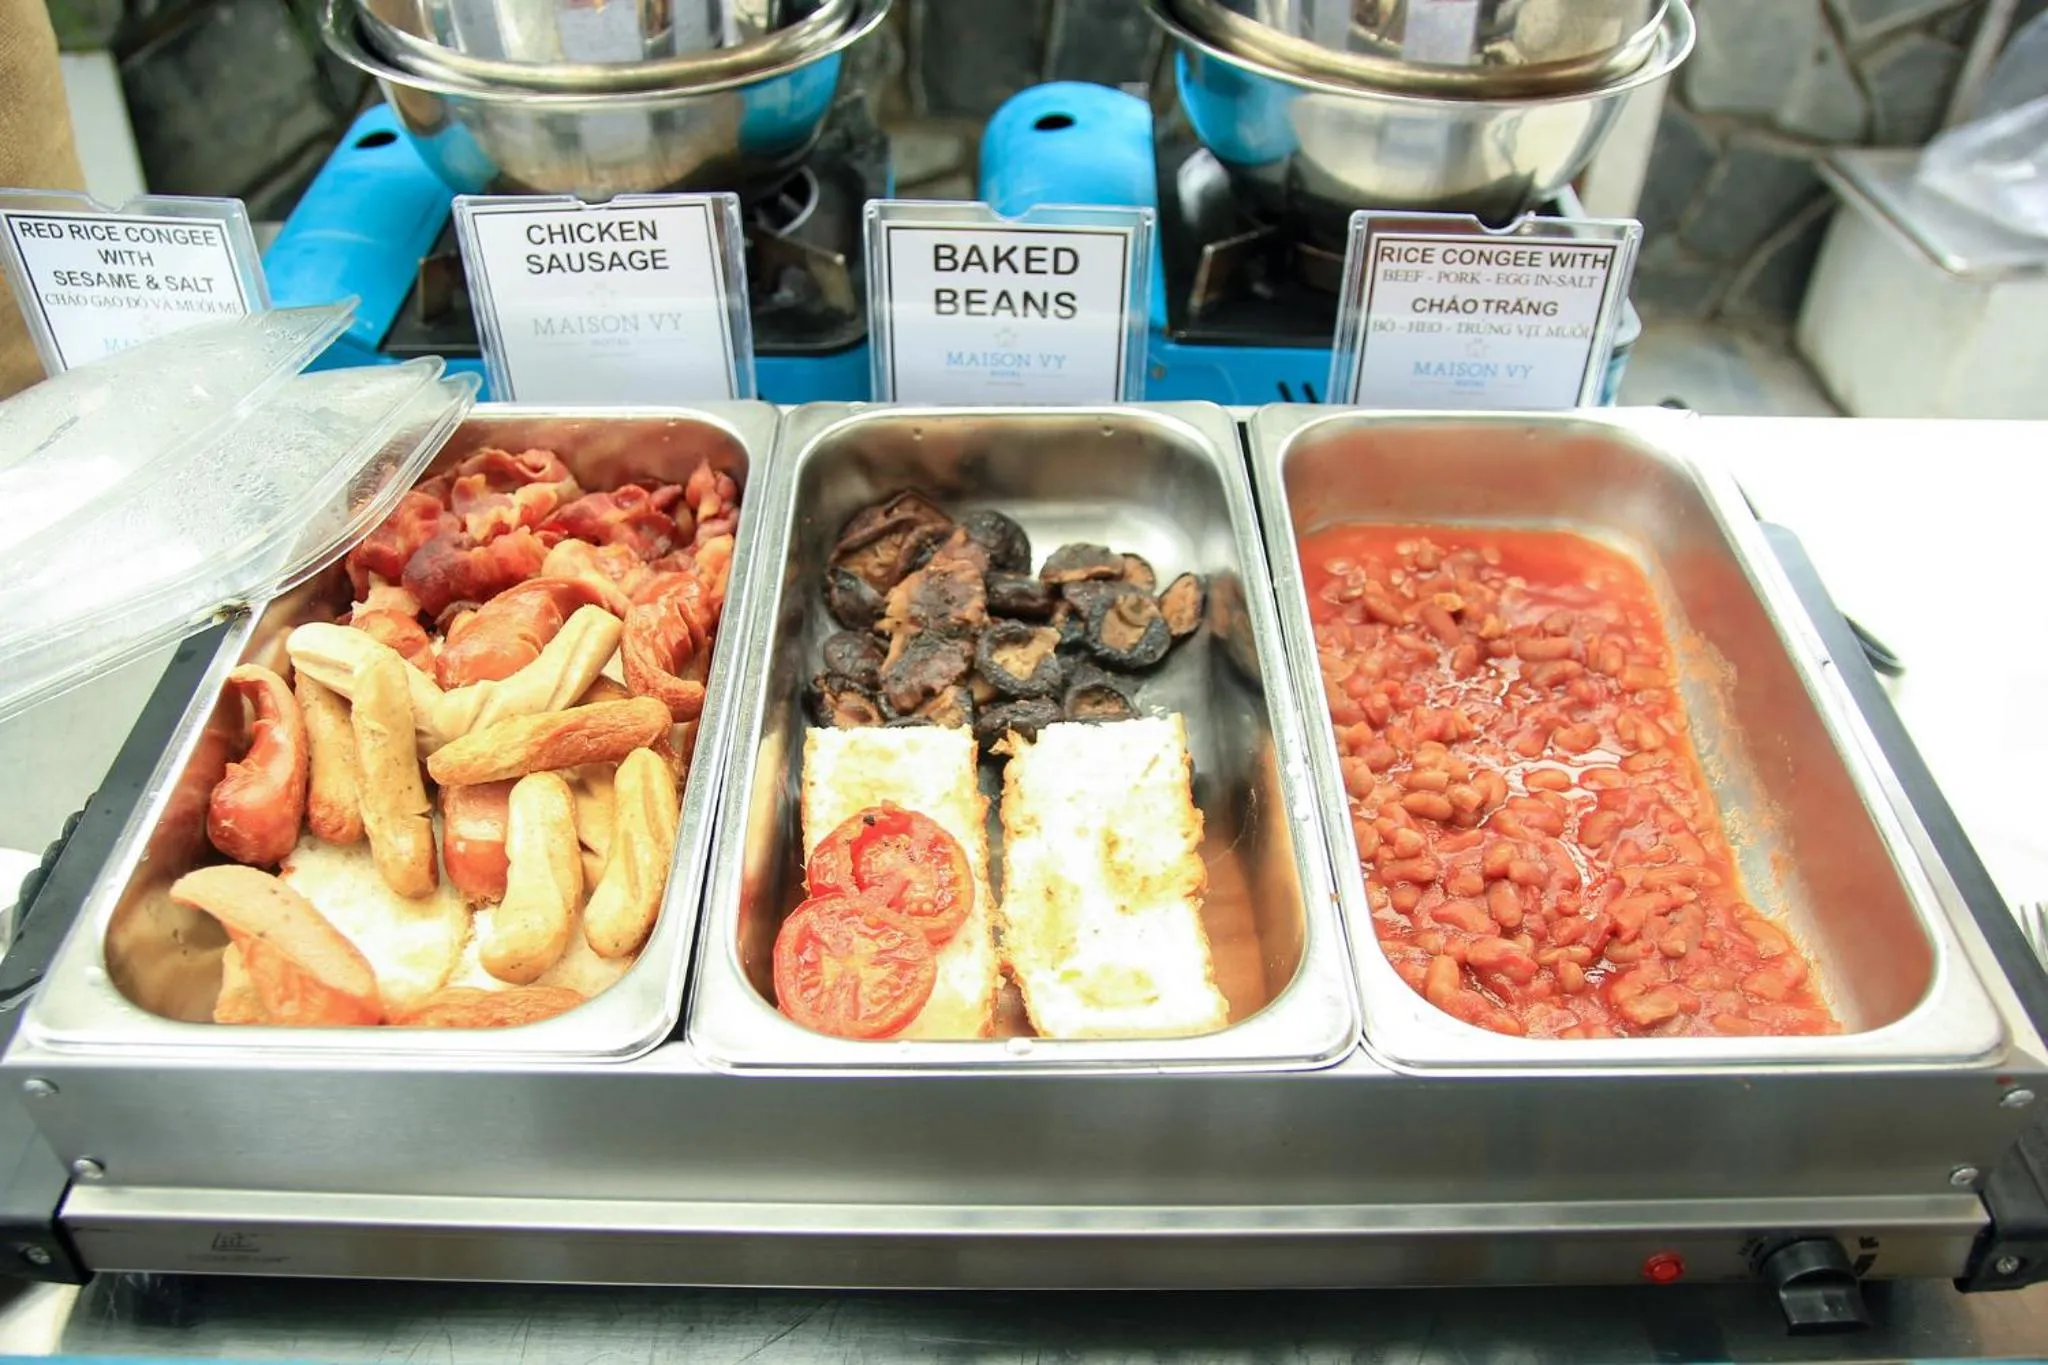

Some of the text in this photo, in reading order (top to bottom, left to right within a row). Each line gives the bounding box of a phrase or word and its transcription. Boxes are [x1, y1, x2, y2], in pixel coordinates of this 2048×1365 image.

[19, 222, 218, 246] RED RICE CONGEE
[526, 220, 659, 245] CHICKEN
[97, 249, 154, 267] WITH
[526, 249, 670, 275] SAUSAGE
[933, 243, 1080, 275] BAKED
[1379, 247, 1609, 270] RICE CONGEE WITH
[53, 270, 213, 293] SESAME & SALT
[1382, 269, 1424, 283] BEEF
[1437, 271, 1481, 285] PORK
[1495, 272, 1530, 286] EGG
[934, 289, 1078, 320] BEANS
[1411, 294, 1478, 315] CHÁO
[533, 312, 683, 336] MAISON VY
[946, 350, 1067, 369] MAISON VY
[1412, 361, 1534, 379] MAISON VY
